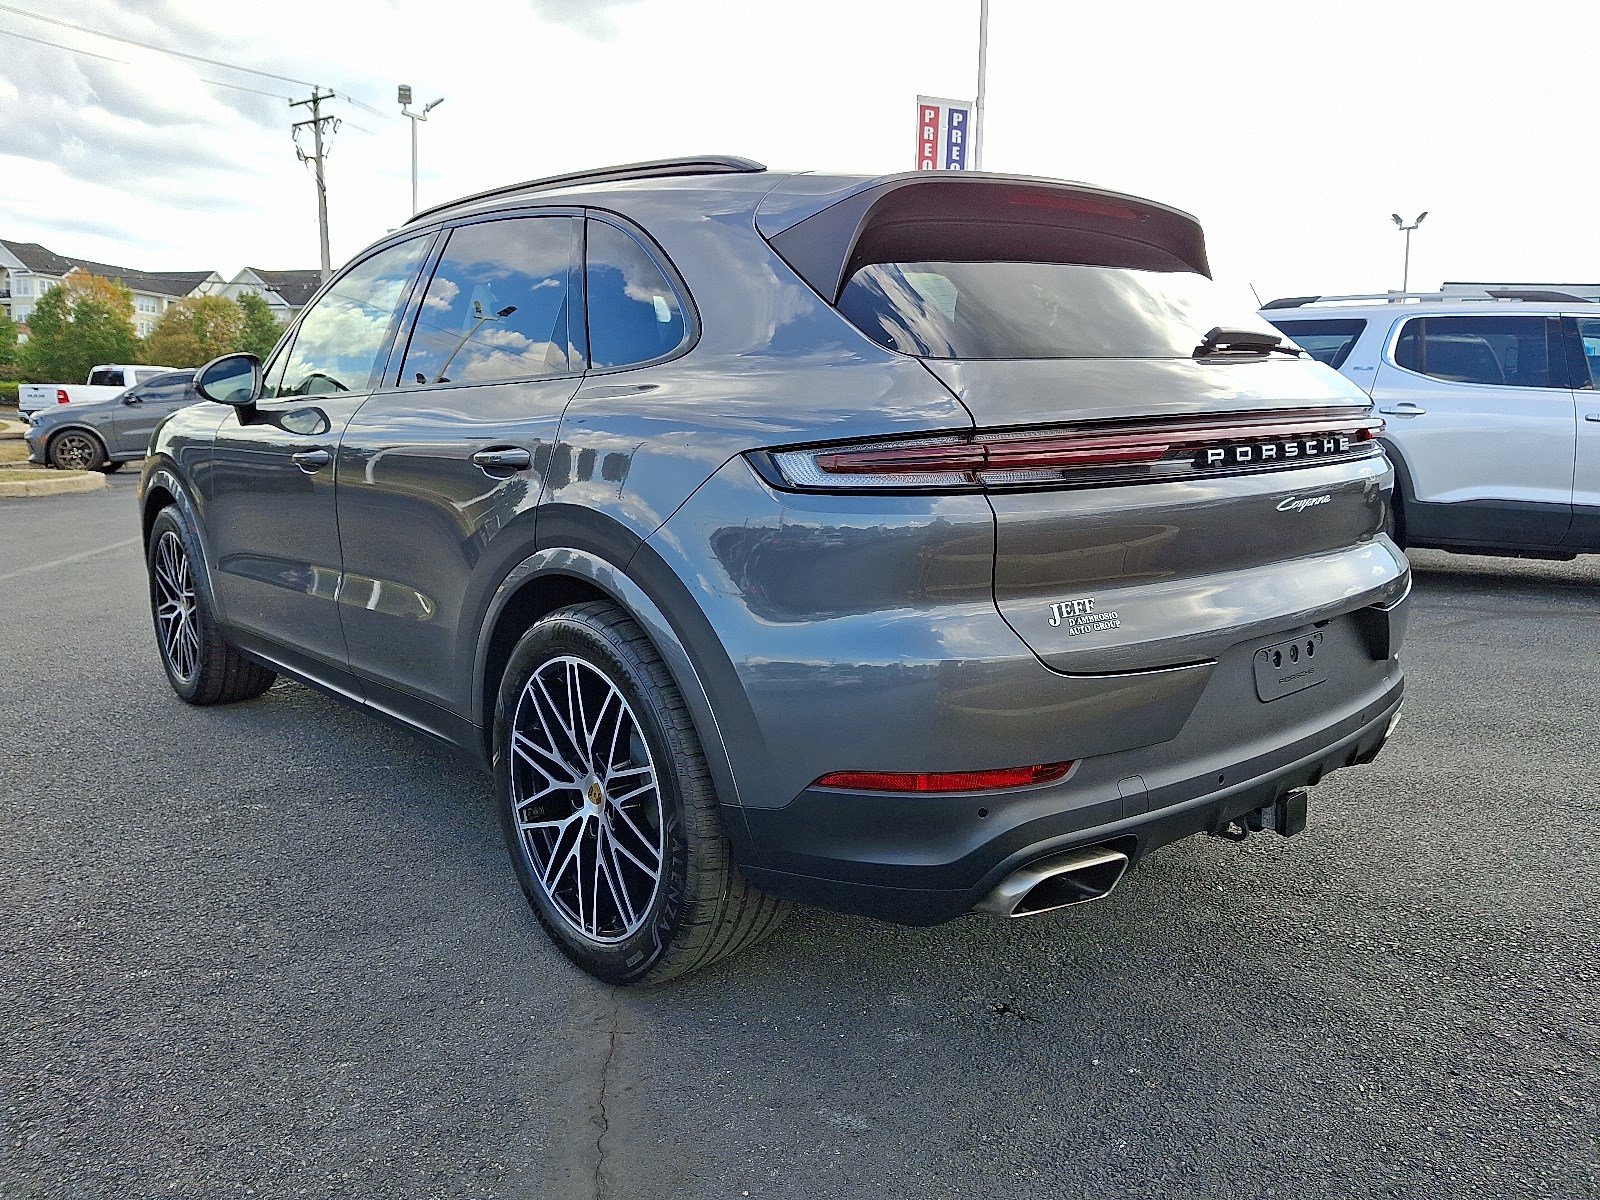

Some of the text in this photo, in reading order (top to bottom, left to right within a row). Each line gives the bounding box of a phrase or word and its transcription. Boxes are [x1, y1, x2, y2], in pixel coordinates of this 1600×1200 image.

[1207, 437, 1350, 464] PORSCHE
[1275, 494, 1332, 512] Cayenne
[1048, 598, 1095, 627] JEFF
[1069, 611, 1119, 627] D'AMBROSIO
[1069, 620, 1121, 636] AUTO GROUP
[660, 837, 687, 931] ALENZA
